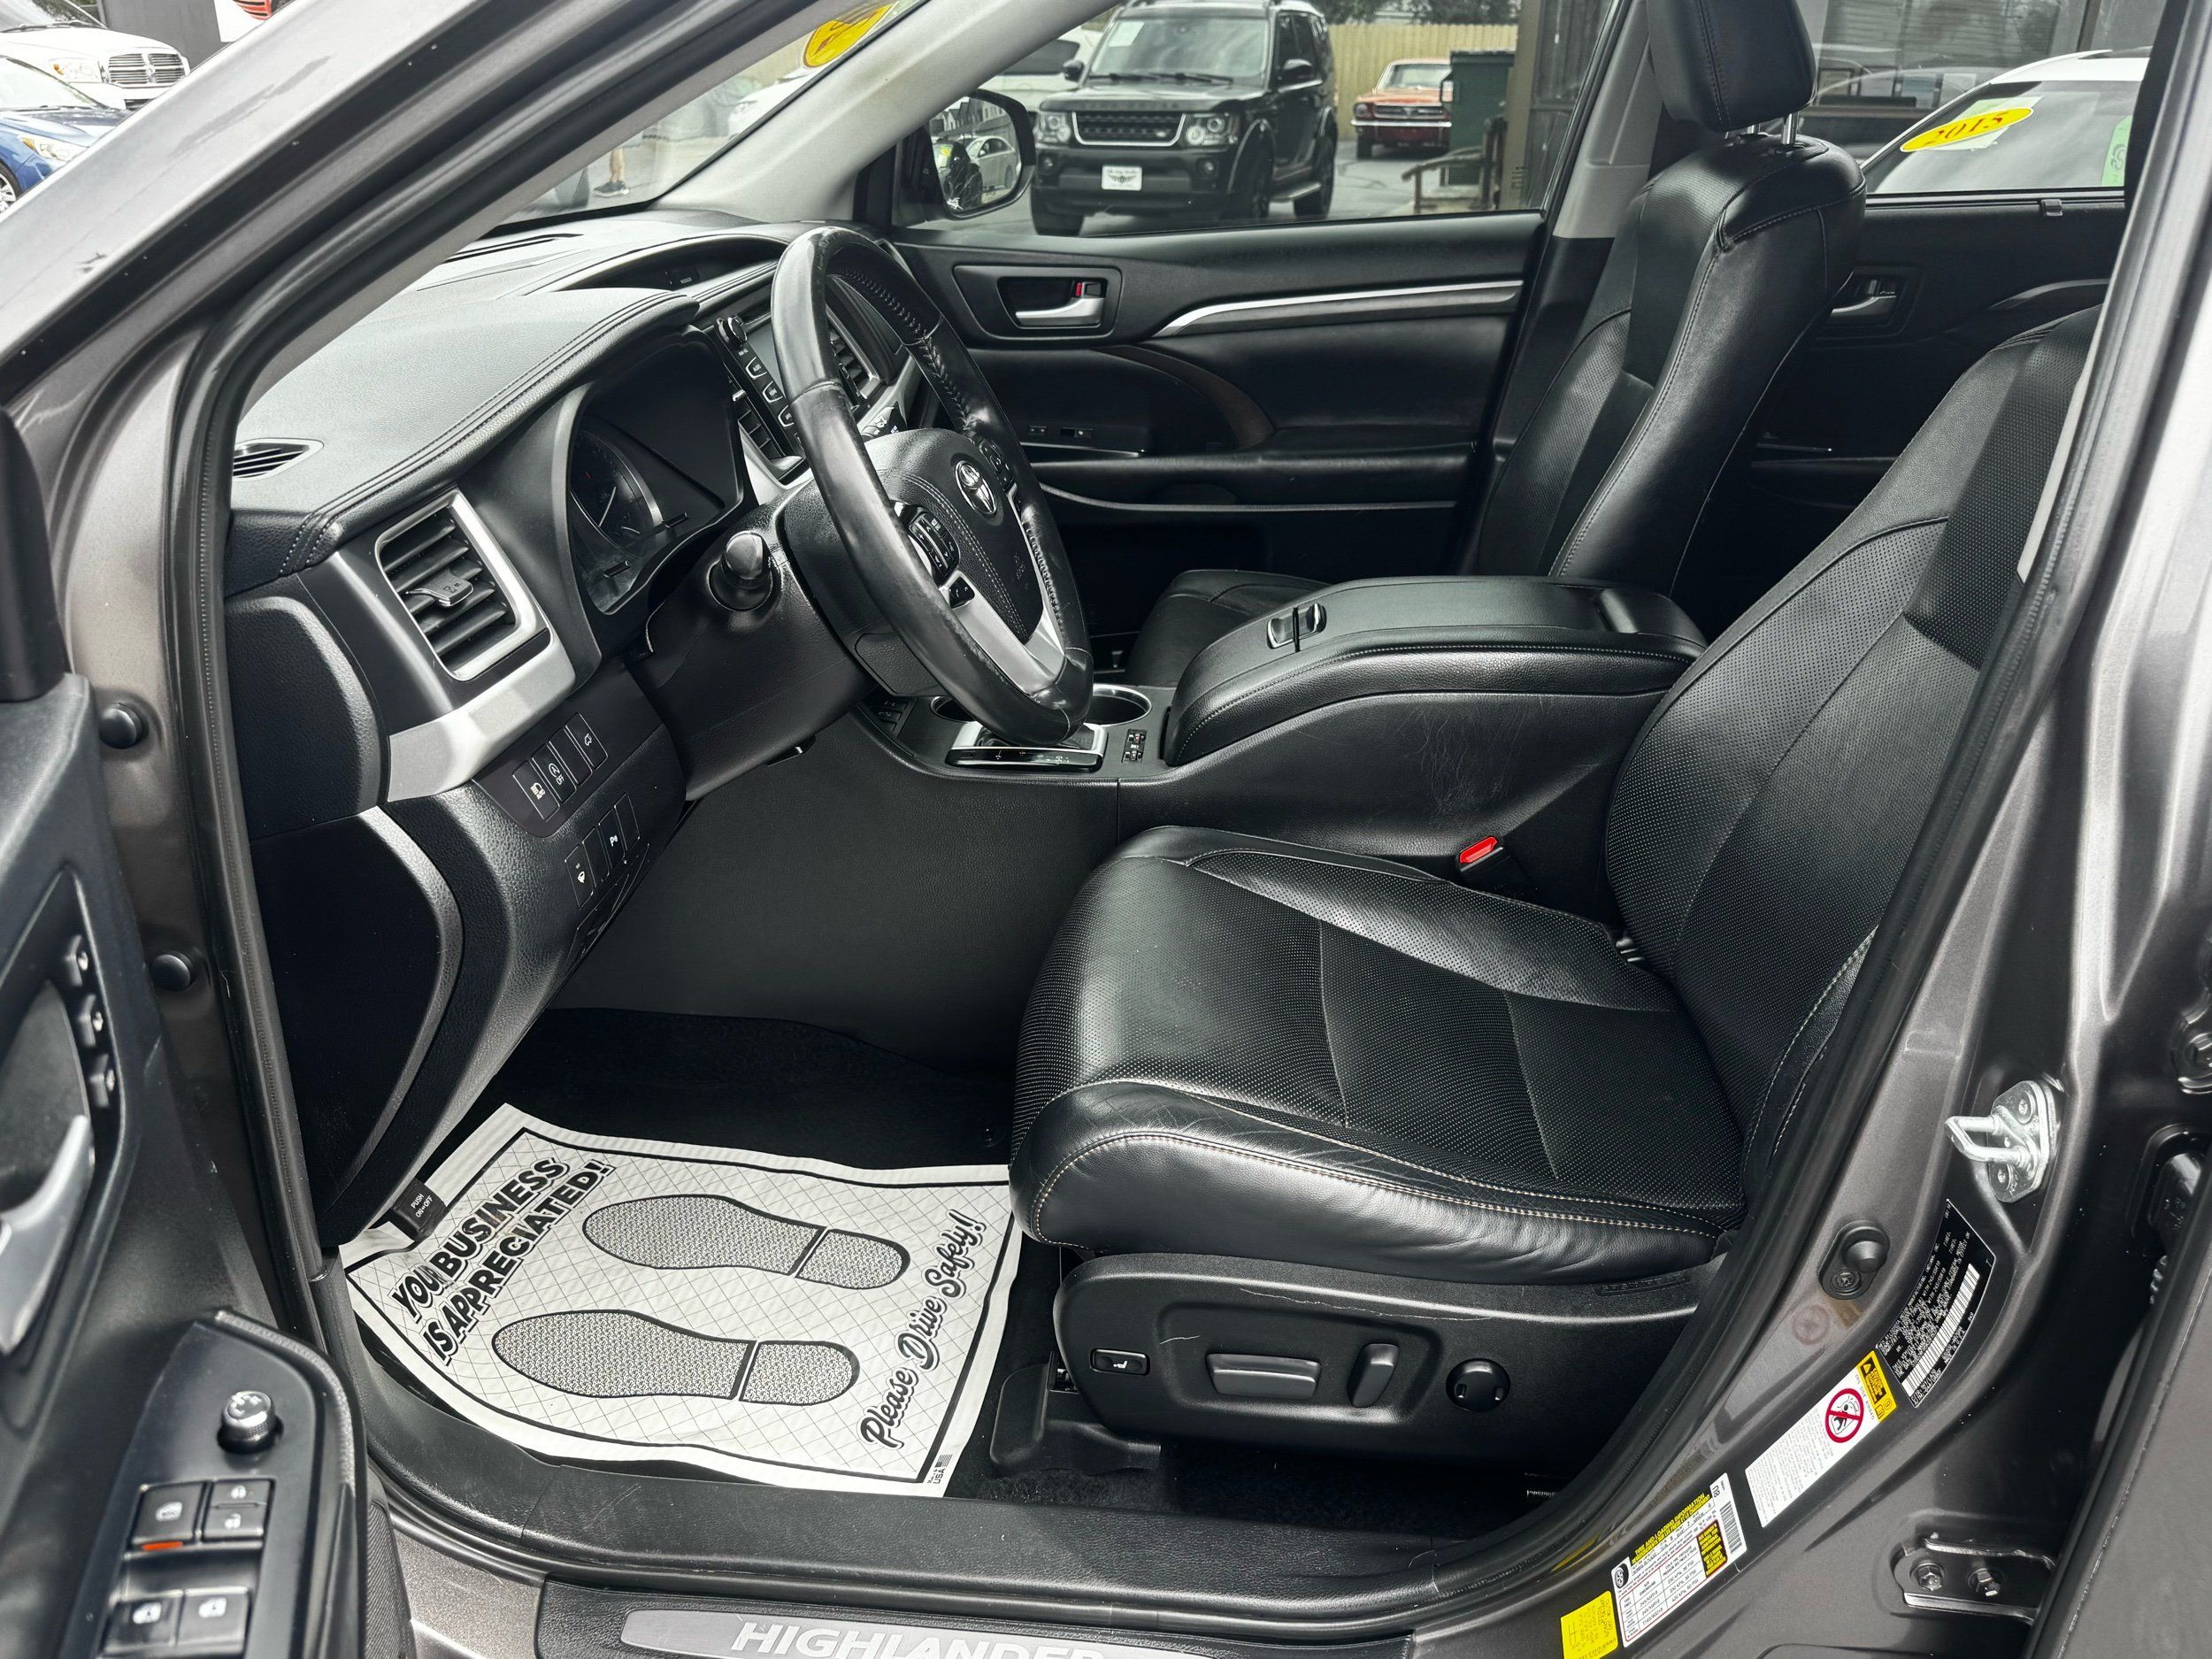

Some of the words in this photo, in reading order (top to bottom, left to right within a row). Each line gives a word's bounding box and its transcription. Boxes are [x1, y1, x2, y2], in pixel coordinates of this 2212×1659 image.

[555, 773, 565, 785] OFF
[410, 1193, 425, 1209] PUSH
[390, 1263, 449, 1321] YOUR
[429, 1156, 571, 1279] BUSINESS
[421, 1320, 457, 1364] IS
[441, 1159, 616, 1342] APPRECIATED!
[857, 1367, 918, 1449] Please
[896, 1296, 947, 1371] Drive
[925, 1210, 987, 1299] Safely!
[933, 1468, 945, 1484] USA
[1645, 1534, 1655, 1548] AND
[1654, 1517, 1674, 1540] LOADING
[1673, 1492, 1704, 1523] INFORMATION
